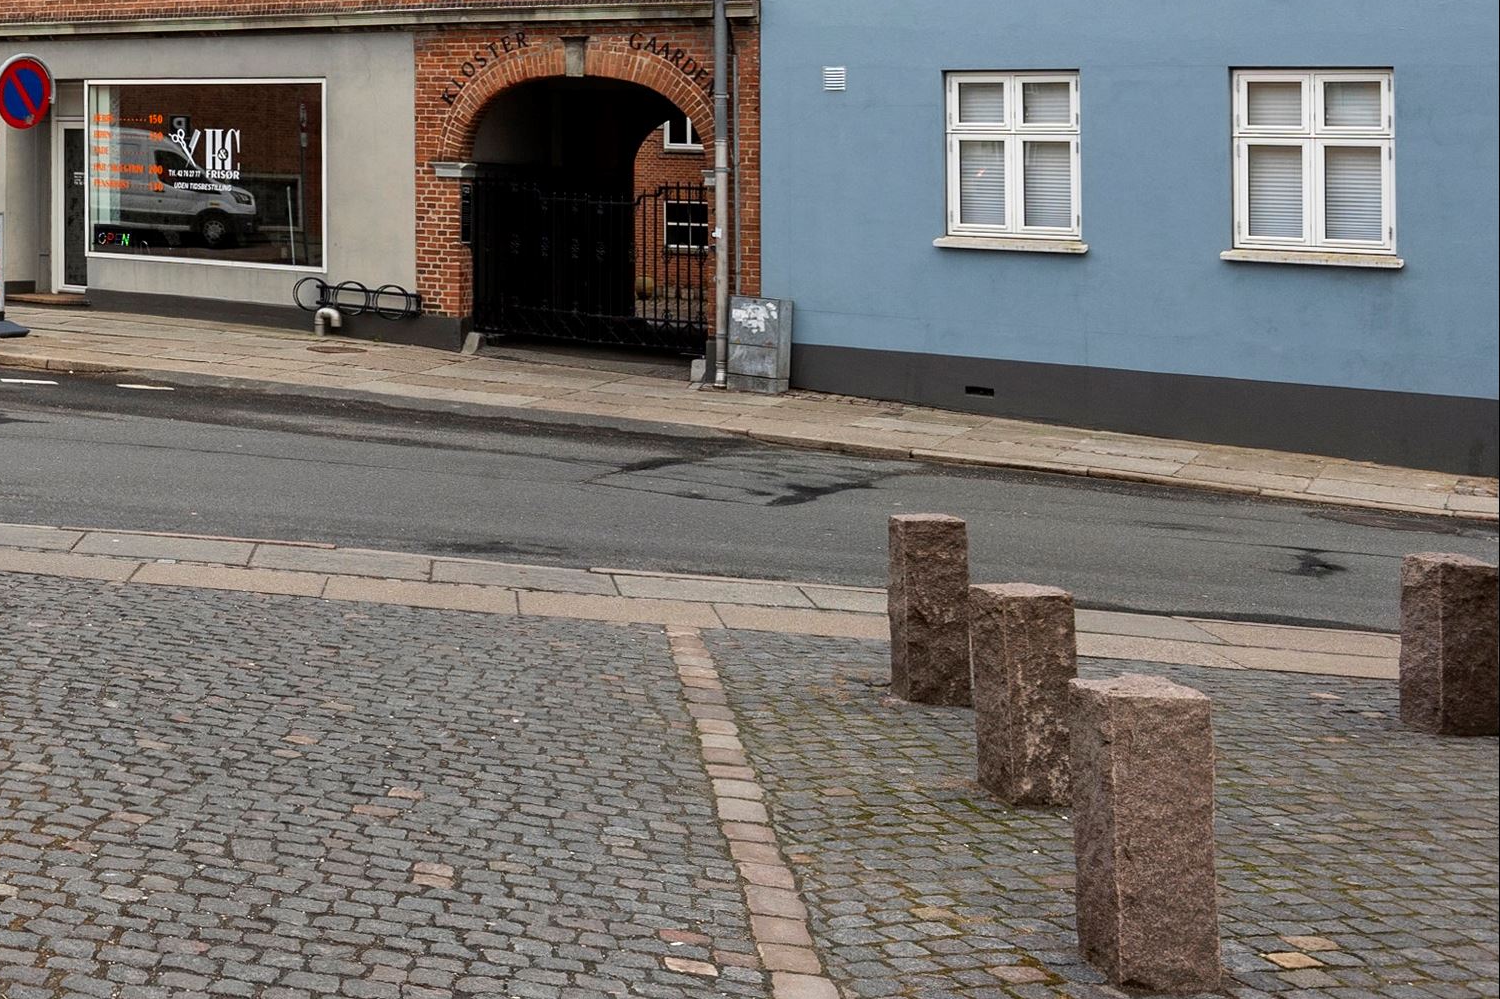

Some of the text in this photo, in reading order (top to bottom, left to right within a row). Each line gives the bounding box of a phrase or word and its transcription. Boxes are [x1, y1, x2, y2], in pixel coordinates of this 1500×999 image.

[441, 31, 529, 107] KLOSTER
[629, 32, 716, 98] GAARDEN
[148, 114, 164, 125] 150
[204, 128, 241, 172] H&C
[205, 169, 240, 180] FRISØR
